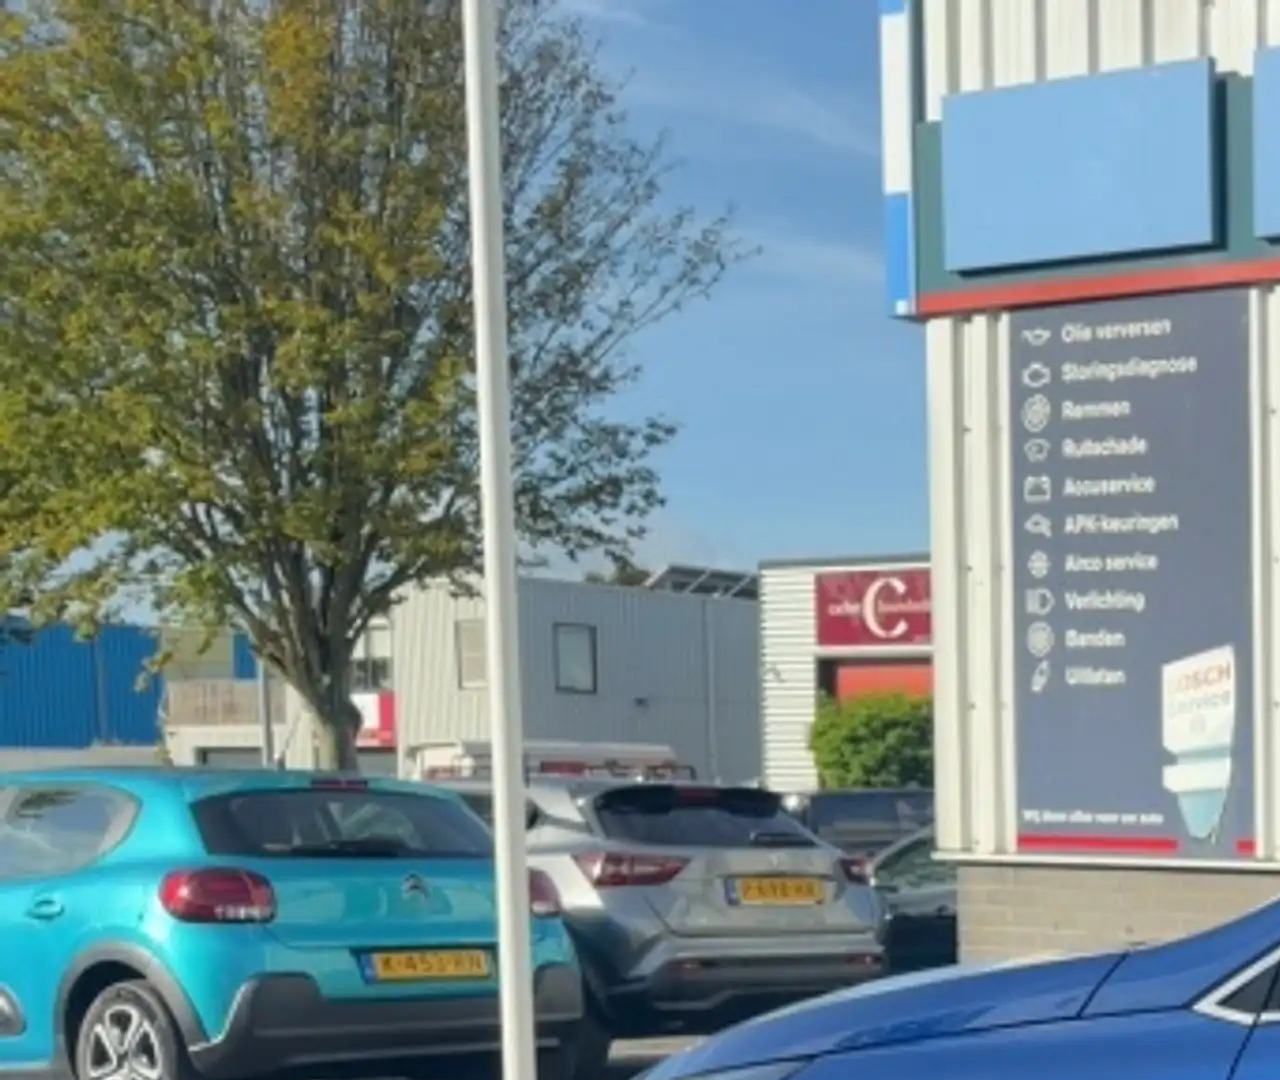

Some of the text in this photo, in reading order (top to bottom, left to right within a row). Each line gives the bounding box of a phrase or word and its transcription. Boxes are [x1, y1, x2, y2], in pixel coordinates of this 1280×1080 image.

[1061, 324, 1092, 343] Olie
[1062, 400, 1130, 420] Remmen
[1105, 553, 1158, 570] service
[1064, 590, 1146, 612] Verlichting
[1064, 628, 1125, 648] Banden
